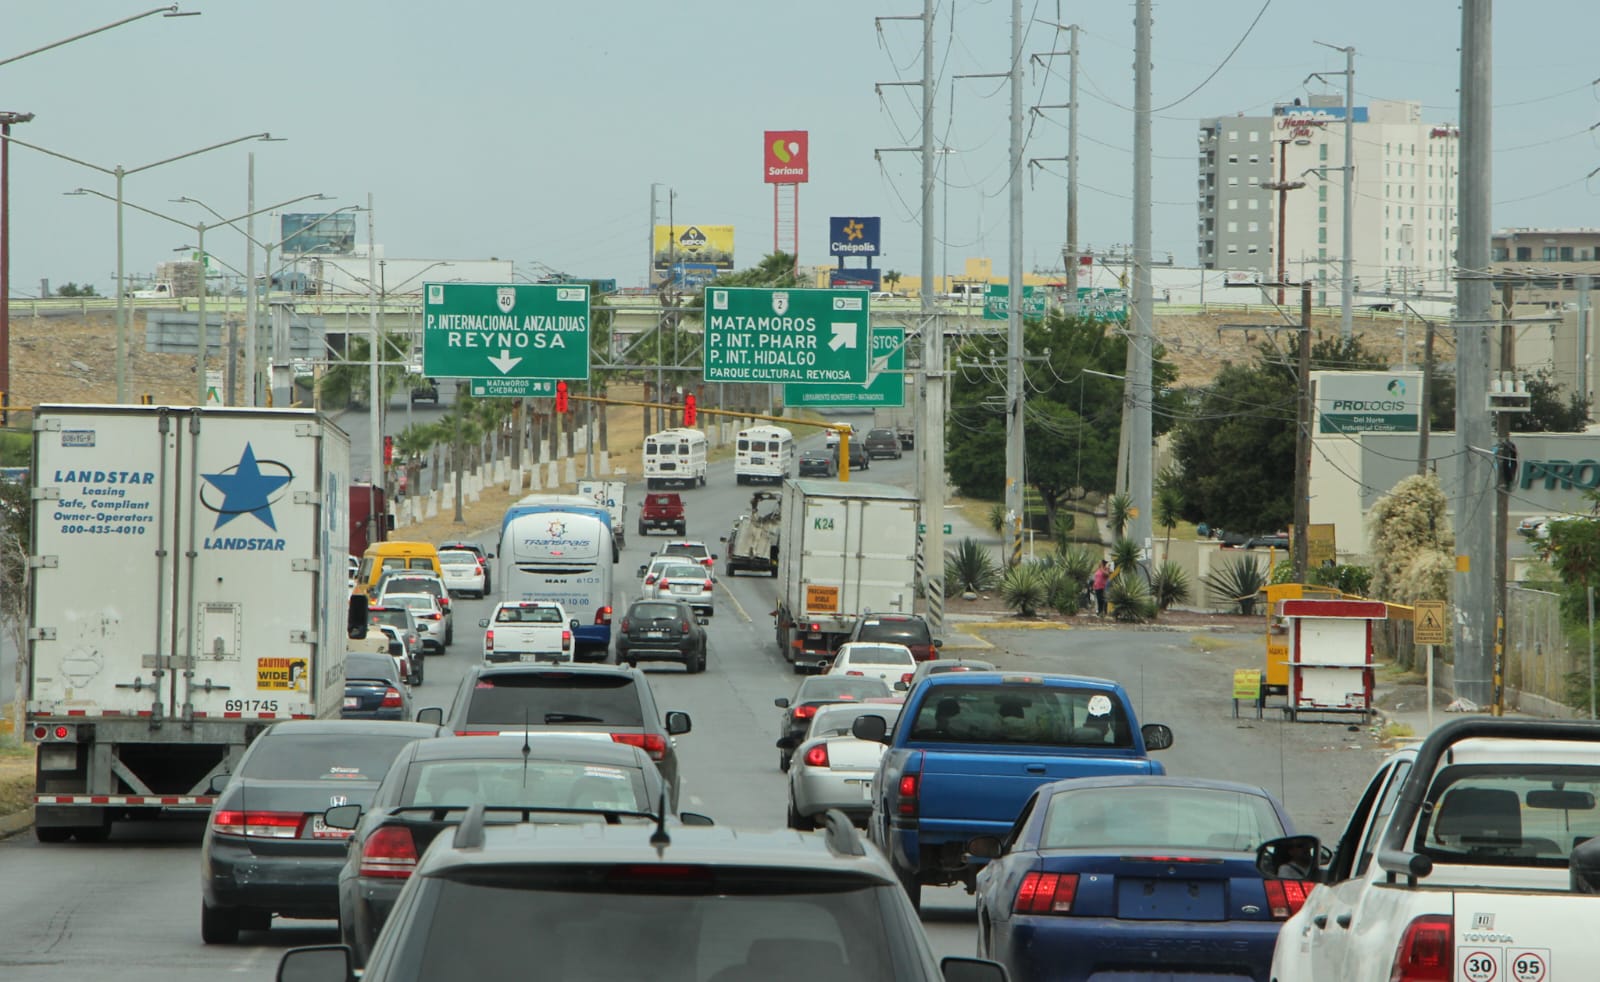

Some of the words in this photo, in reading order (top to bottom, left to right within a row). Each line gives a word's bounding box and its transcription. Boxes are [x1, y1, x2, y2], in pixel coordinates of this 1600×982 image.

[769, 166, 804, 176] Soriana
[832, 242, 875, 253] Cinépolis
[501, 296, 511, 306] 40
[778, 300, 783, 309] 2
[428, 314, 437, 330] P.
[439, 314, 520, 331] INTERNACIONAL
[523, 316, 585, 332] ANZALDUAS
[710, 316, 816, 332] MATAMOROS
[448, 332, 565, 348] REYNOSA
[710, 333, 722, 347] P.
[727, 334, 754, 348] INT.
[759, 334, 817, 349] PHARR
[710, 350, 722, 364] P.
[726, 350, 751, 364] INT.
[754, 351, 816, 365] HIDALGO
[710, 368, 749, 379] PARQUE
[752, 369, 802, 379] CULTURAL
[807, 370, 850, 380] REYNOSA
[1333, 400, 1405, 411] PROLOGIS
[54, 470, 155, 484] LANDSTAR
[1520, 459, 1600, 490] PRO
[82, 487, 125, 497] Leasing
[58, 499, 86, 509] Safe,
[91, 500, 149, 510] Compliant
[54, 512, 153, 523] Owner-Operators
[61, 525, 145, 534] 800-435-4010
[814, 518, 834, 530] K24
[204, 538, 286, 551] LANDSTAR
[258, 658, 290, 668] CAUTION
[259, 672, 288, 680] WIDE
[225, 700, 278, 711] 691745
[1463, 933, 1513, 943] TOYOTA
[1469, 959, 1492, 973] 30
[1517, 961, 1540, 974] 95
